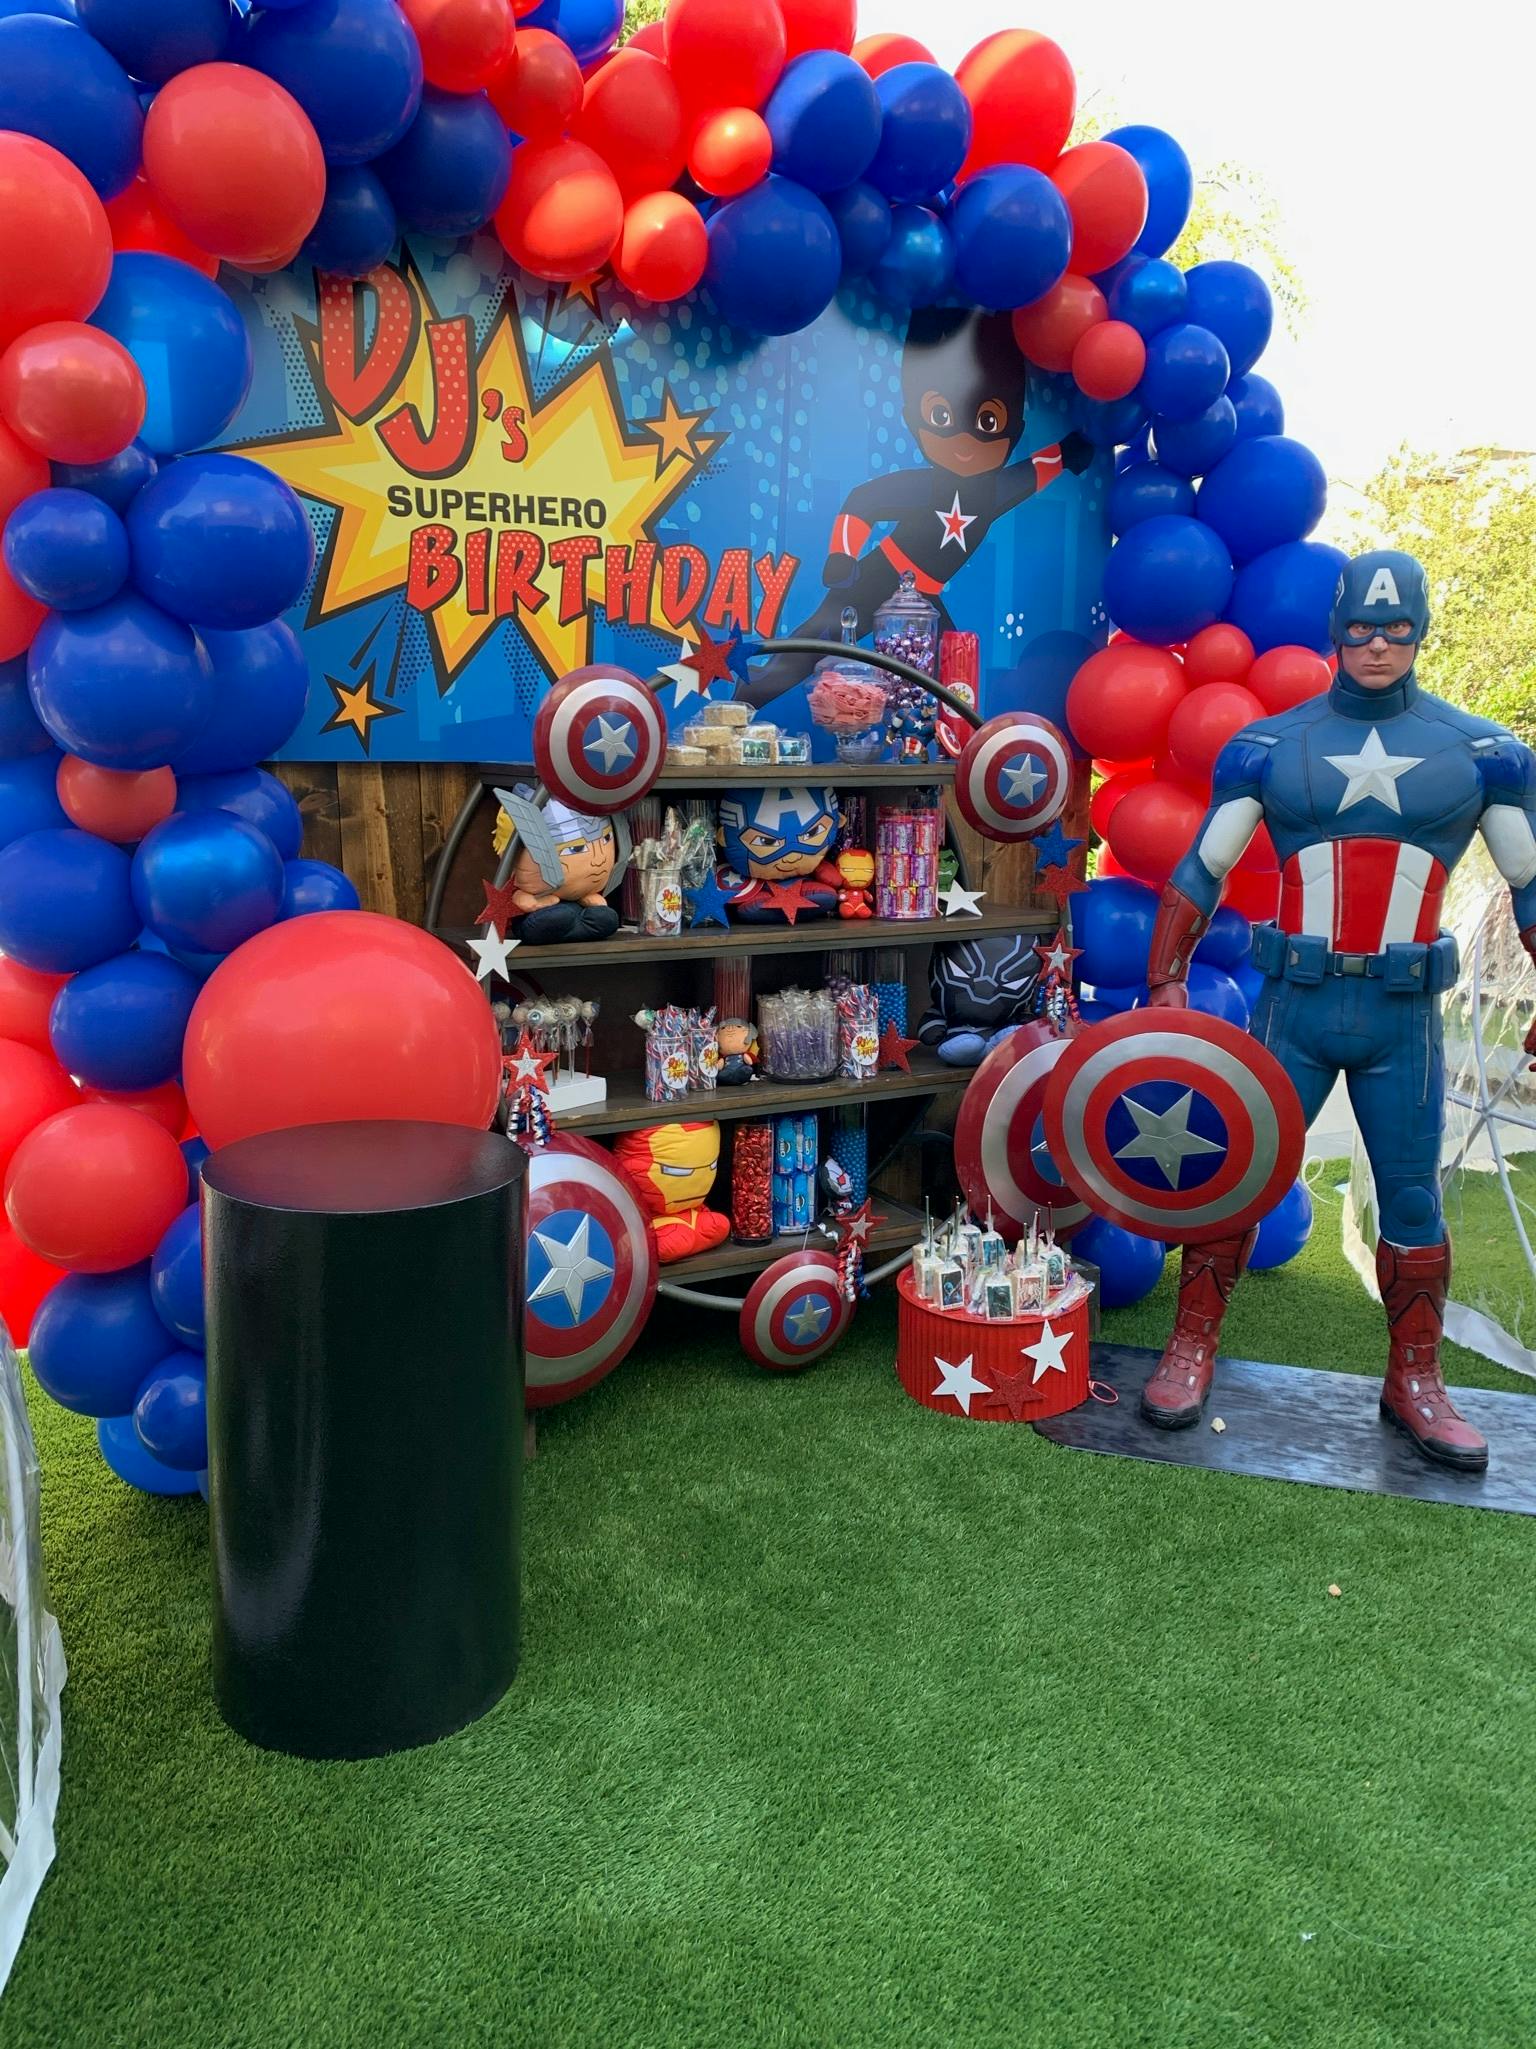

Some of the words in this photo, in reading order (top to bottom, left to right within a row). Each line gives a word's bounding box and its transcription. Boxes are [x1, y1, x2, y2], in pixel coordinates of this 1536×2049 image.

[312, 260, 528, 480] DJ's
[387, 485, 607, 529] SUPERHERO
[406, 524, 800, 638] BIRTHDAY
[1363, 567, 1400, 606] A
[754, 787, 820, 831] A
